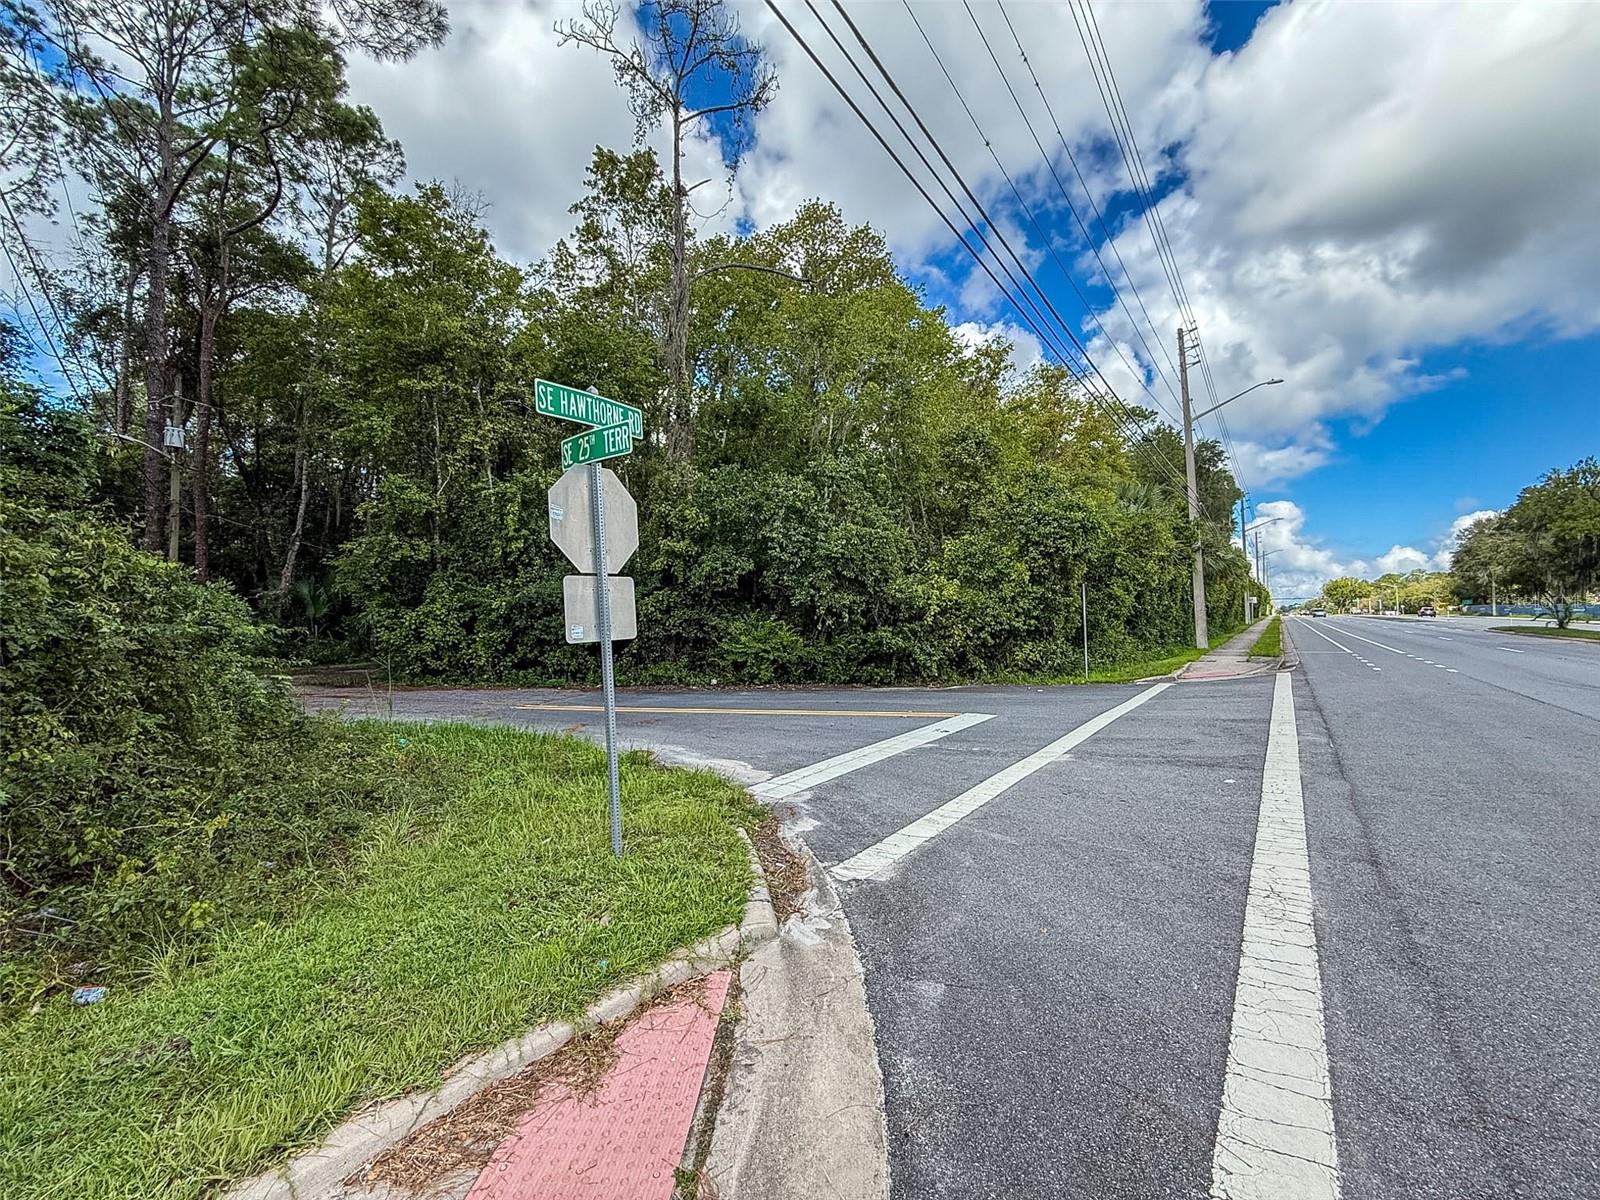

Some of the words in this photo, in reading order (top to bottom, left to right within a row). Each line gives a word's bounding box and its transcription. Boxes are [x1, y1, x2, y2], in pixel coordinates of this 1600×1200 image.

[538, 384, 555, 411] SE
[560, 390, 624, 426] HAWTHORNE
[627, 410, 641, 434] RD
[563, 442, 574, 466] SE
[578, 434, 596, 461] 25TH
[603, 425, 630, 453] TERR
